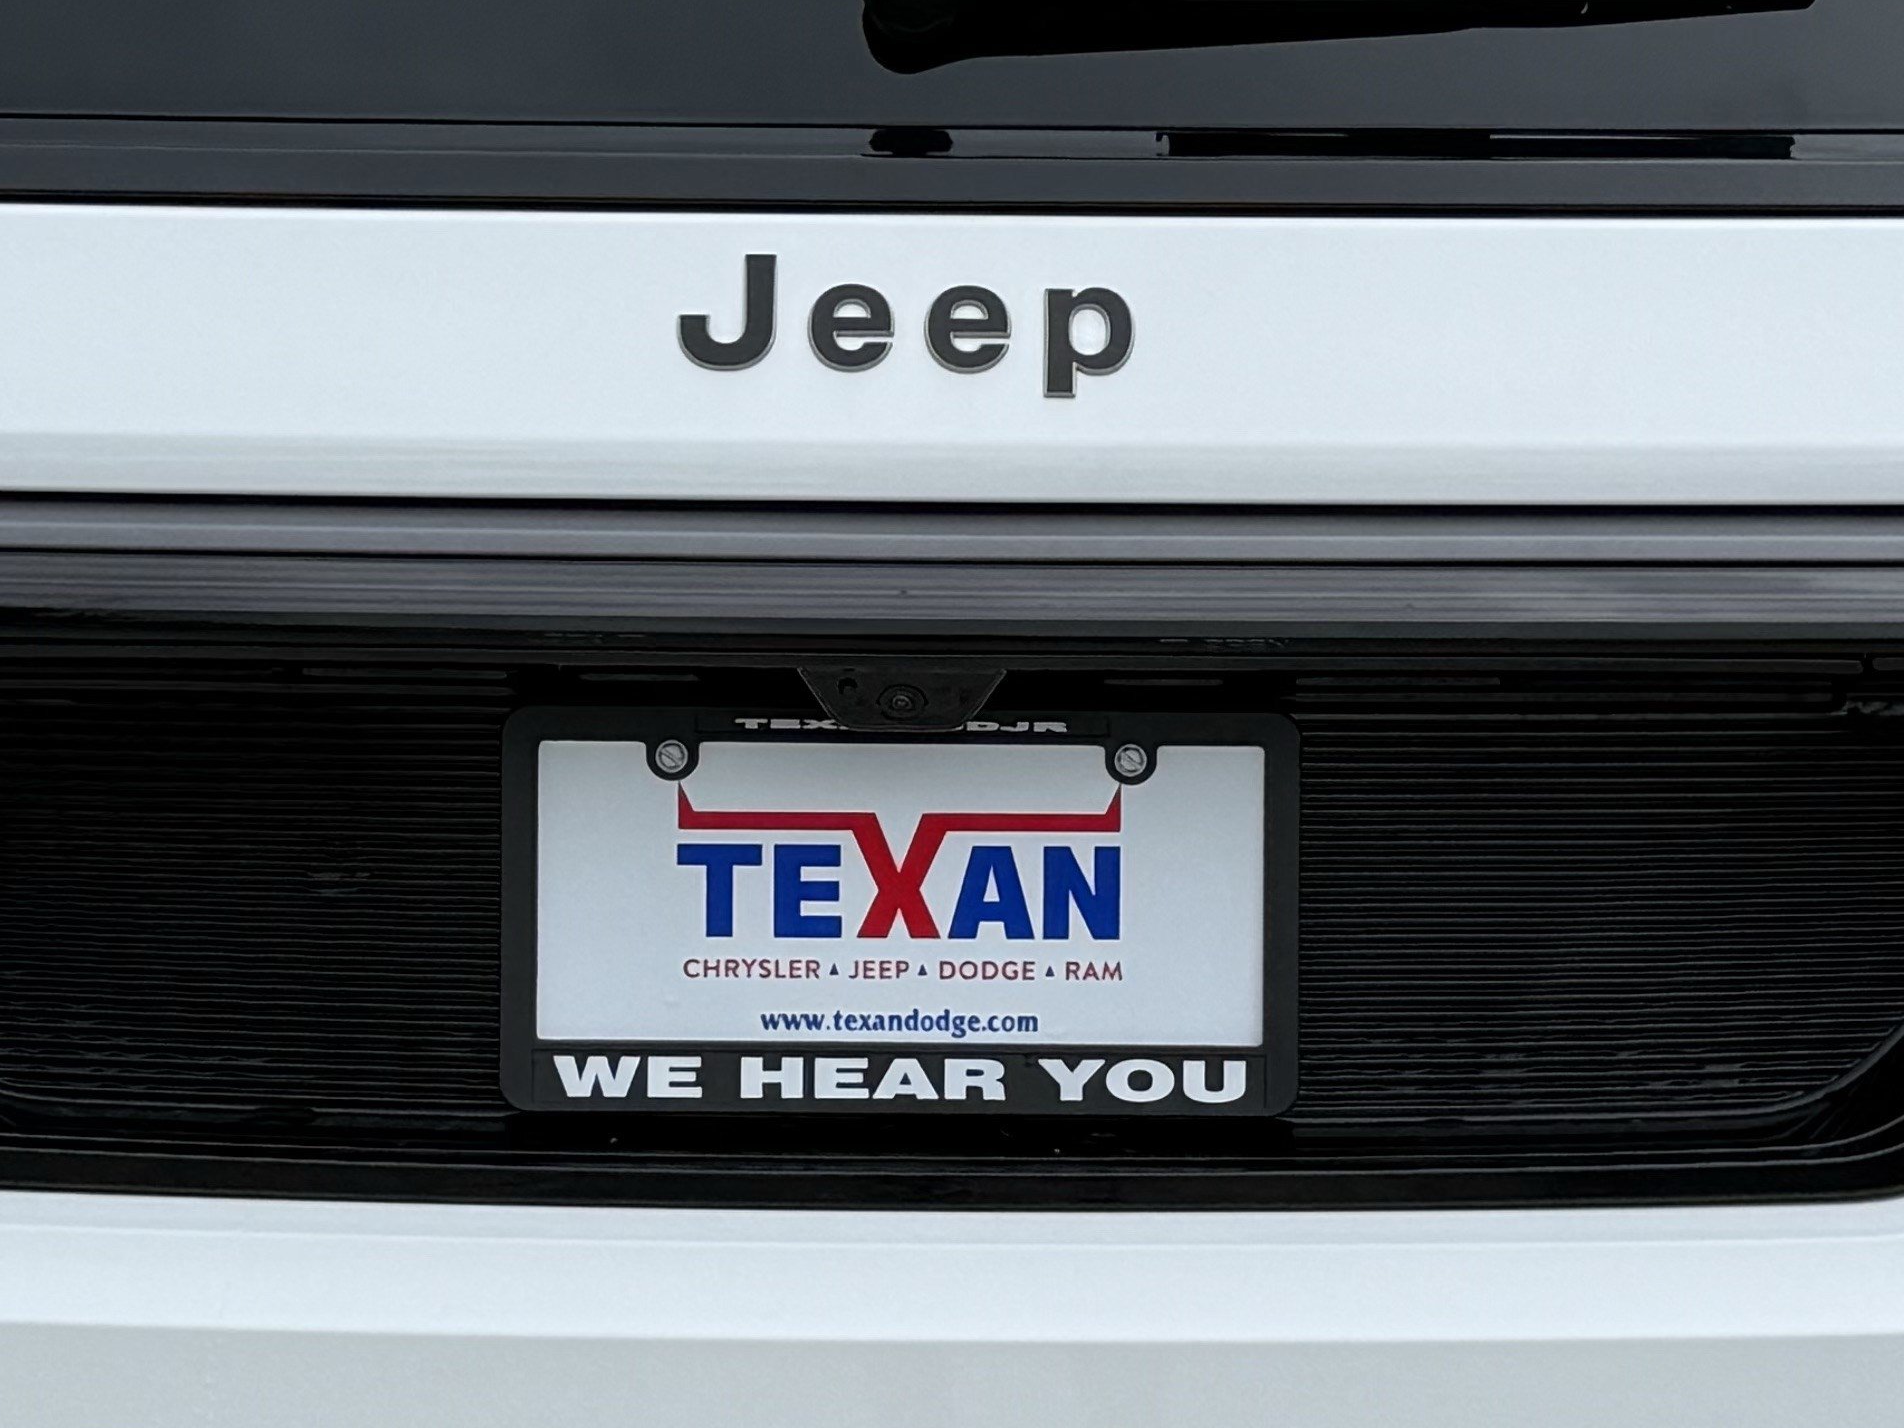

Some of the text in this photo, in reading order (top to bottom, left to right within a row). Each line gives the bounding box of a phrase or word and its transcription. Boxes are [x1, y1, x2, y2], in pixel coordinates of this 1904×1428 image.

[677, 253, 1137, 399] Jeep
[954, 721, 1068, 733] DJR
[676, 812, 1122, 942] TEXAN
[682, 958, 1124, 982] CHRYSLER JEEP DODGE RAM
[759, 1008, 1040, 1039] www.texandodge.com
[552, 1055, 1247, 1104] WE HEAR YOU
